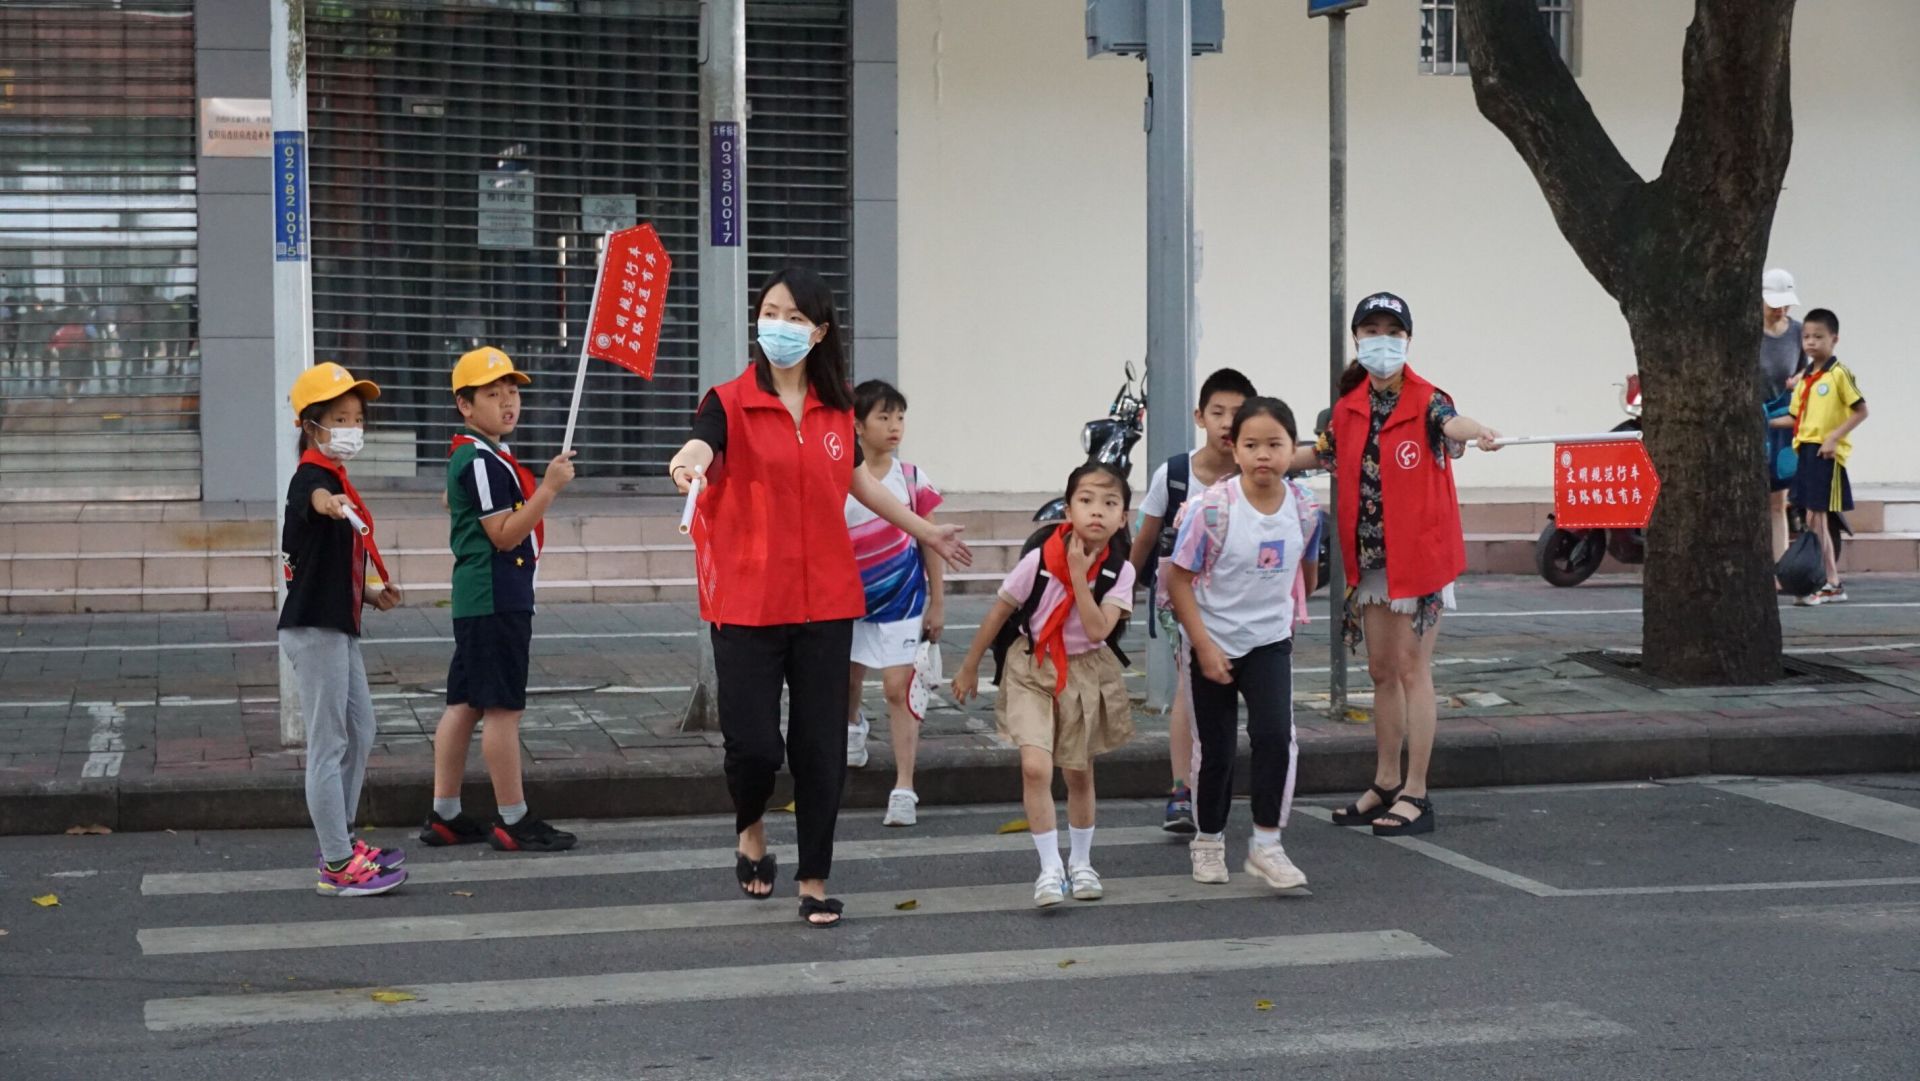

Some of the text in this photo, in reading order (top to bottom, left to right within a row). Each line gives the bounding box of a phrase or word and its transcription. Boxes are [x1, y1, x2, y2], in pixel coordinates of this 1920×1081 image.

[611, 244, 642, 346] 文明规范行车
[628, 250, 656, 353] 马路畅通有序
[1369, 298, 1402, 313] FILA
[1566, 464, 1640, 484] 文明规范行车
[1567, 486, 1643, 505] 马路畅通有序
